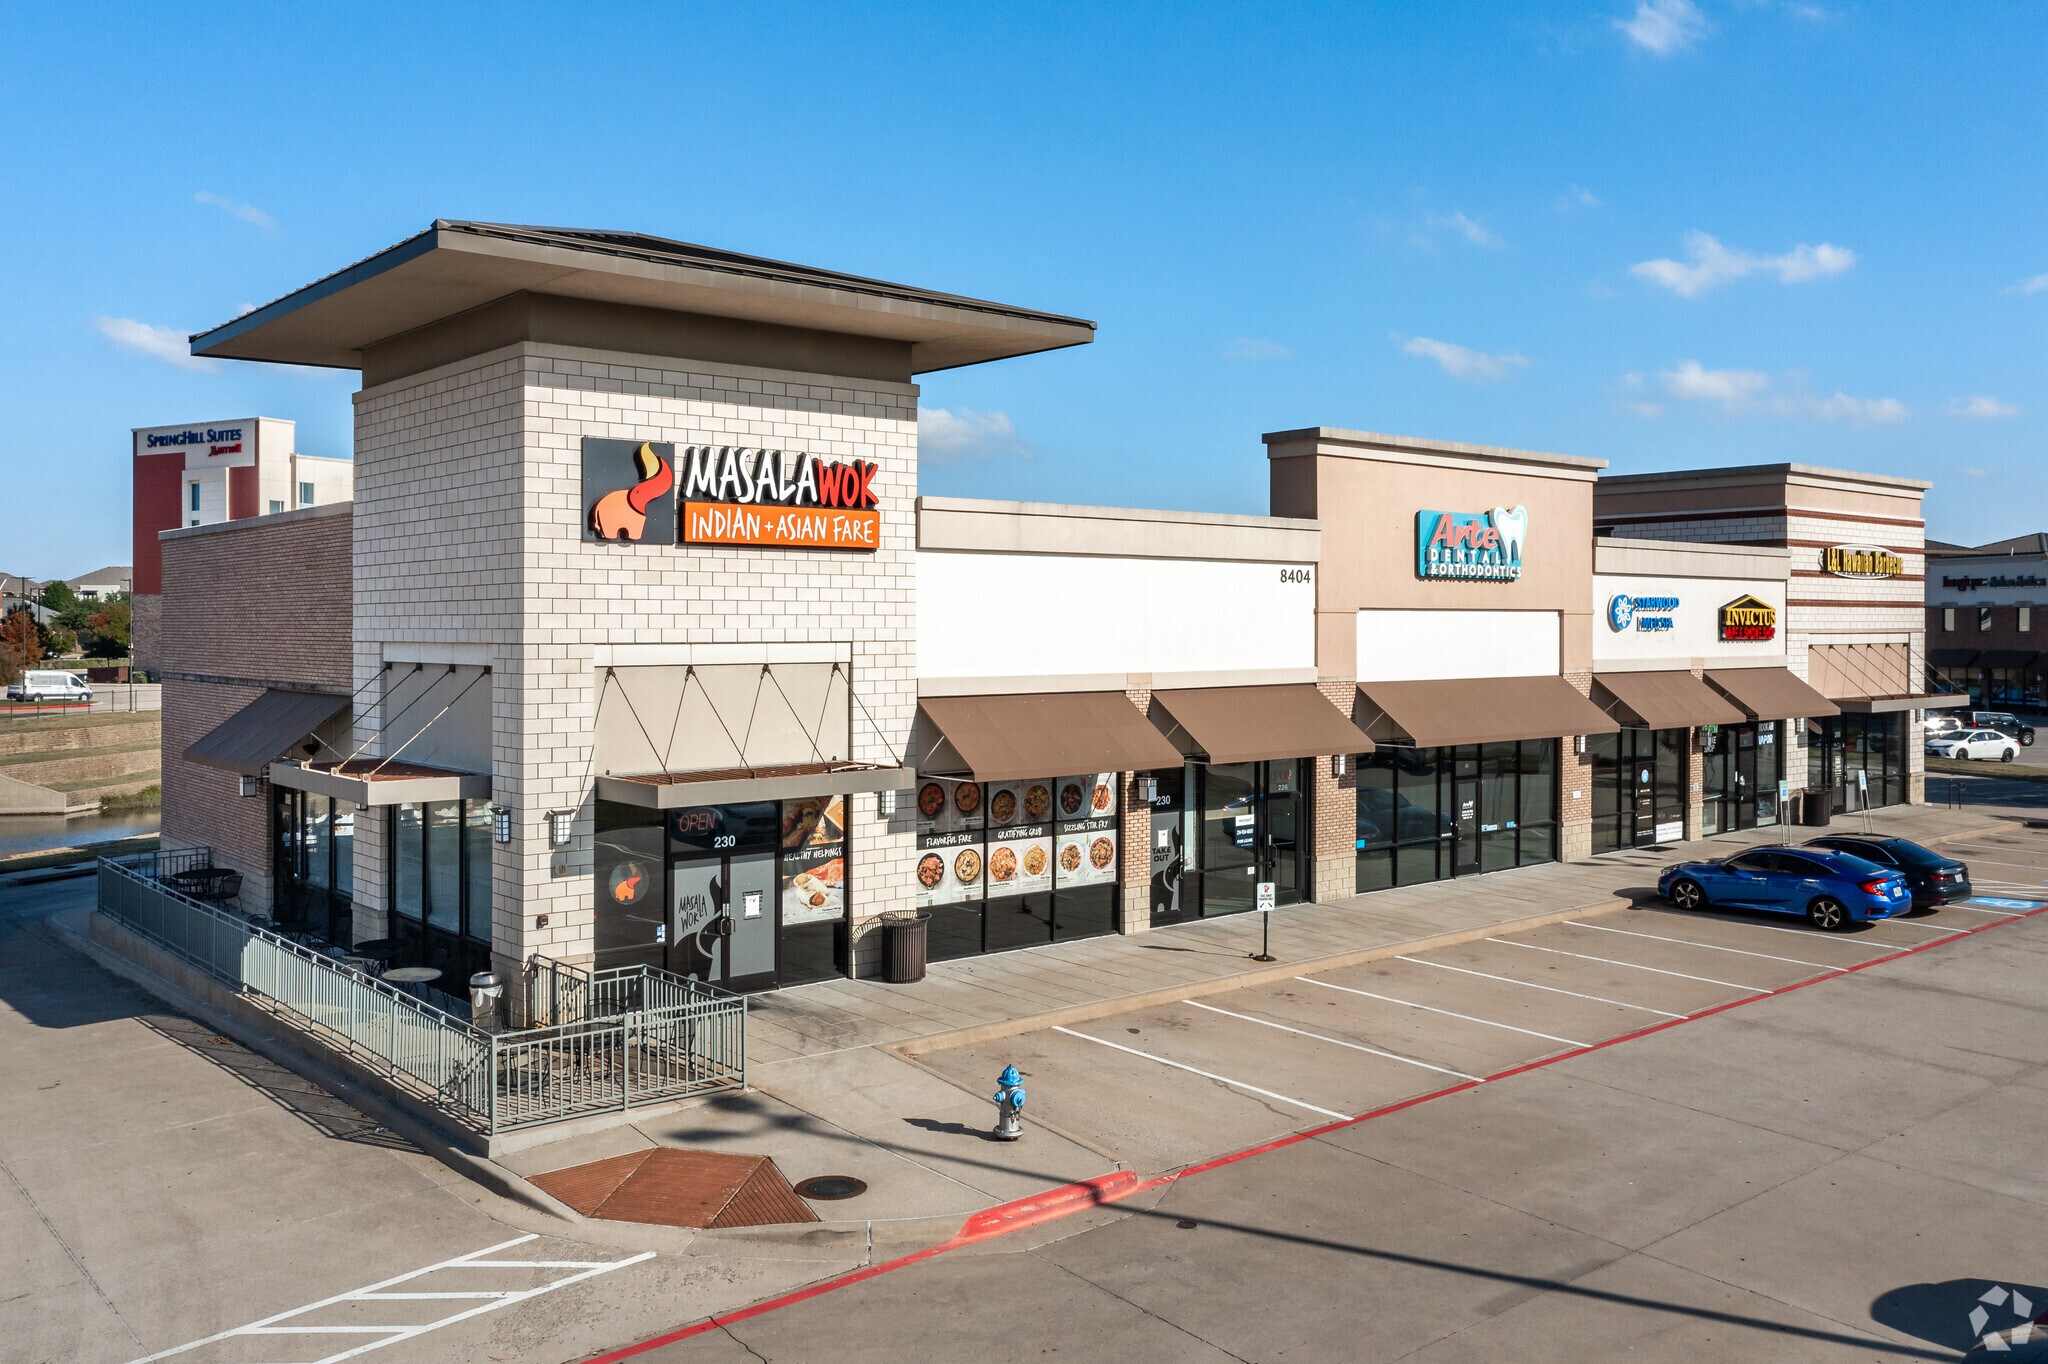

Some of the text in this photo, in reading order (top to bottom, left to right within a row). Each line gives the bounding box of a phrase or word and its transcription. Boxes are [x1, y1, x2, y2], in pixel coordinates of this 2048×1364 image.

[206, 428, 242, 442] SUITES
[692, 506, 760, 541] INDIAN
[775, 513, 828, 542] ASIAN
[833, 515, 874, 543] FARE
[1430, 513, 1500, 549] Arte
[1430, 548, 1501, 565] DENTAL
[1280, 569, 1311, 584] 8404
[1725, 609, 1776, 626] INVICTUS
[1156, 795, 1171, 806] 230
[680, 812, 716, 832] OPEN
[1098, 819, 1109, 829] FRY
[714, 835, 736, 848] 230
[926, 834, 973, 848] FLAVORFUL FARE
[813, 846, 842, 859] HELPINGS
[1152, 847, 1171, 855] TAKE
[1153, 854, 1170, 862] OUT
[678, 893, 708, 917] MASALA
[681, 911, 699, 933] WOK
